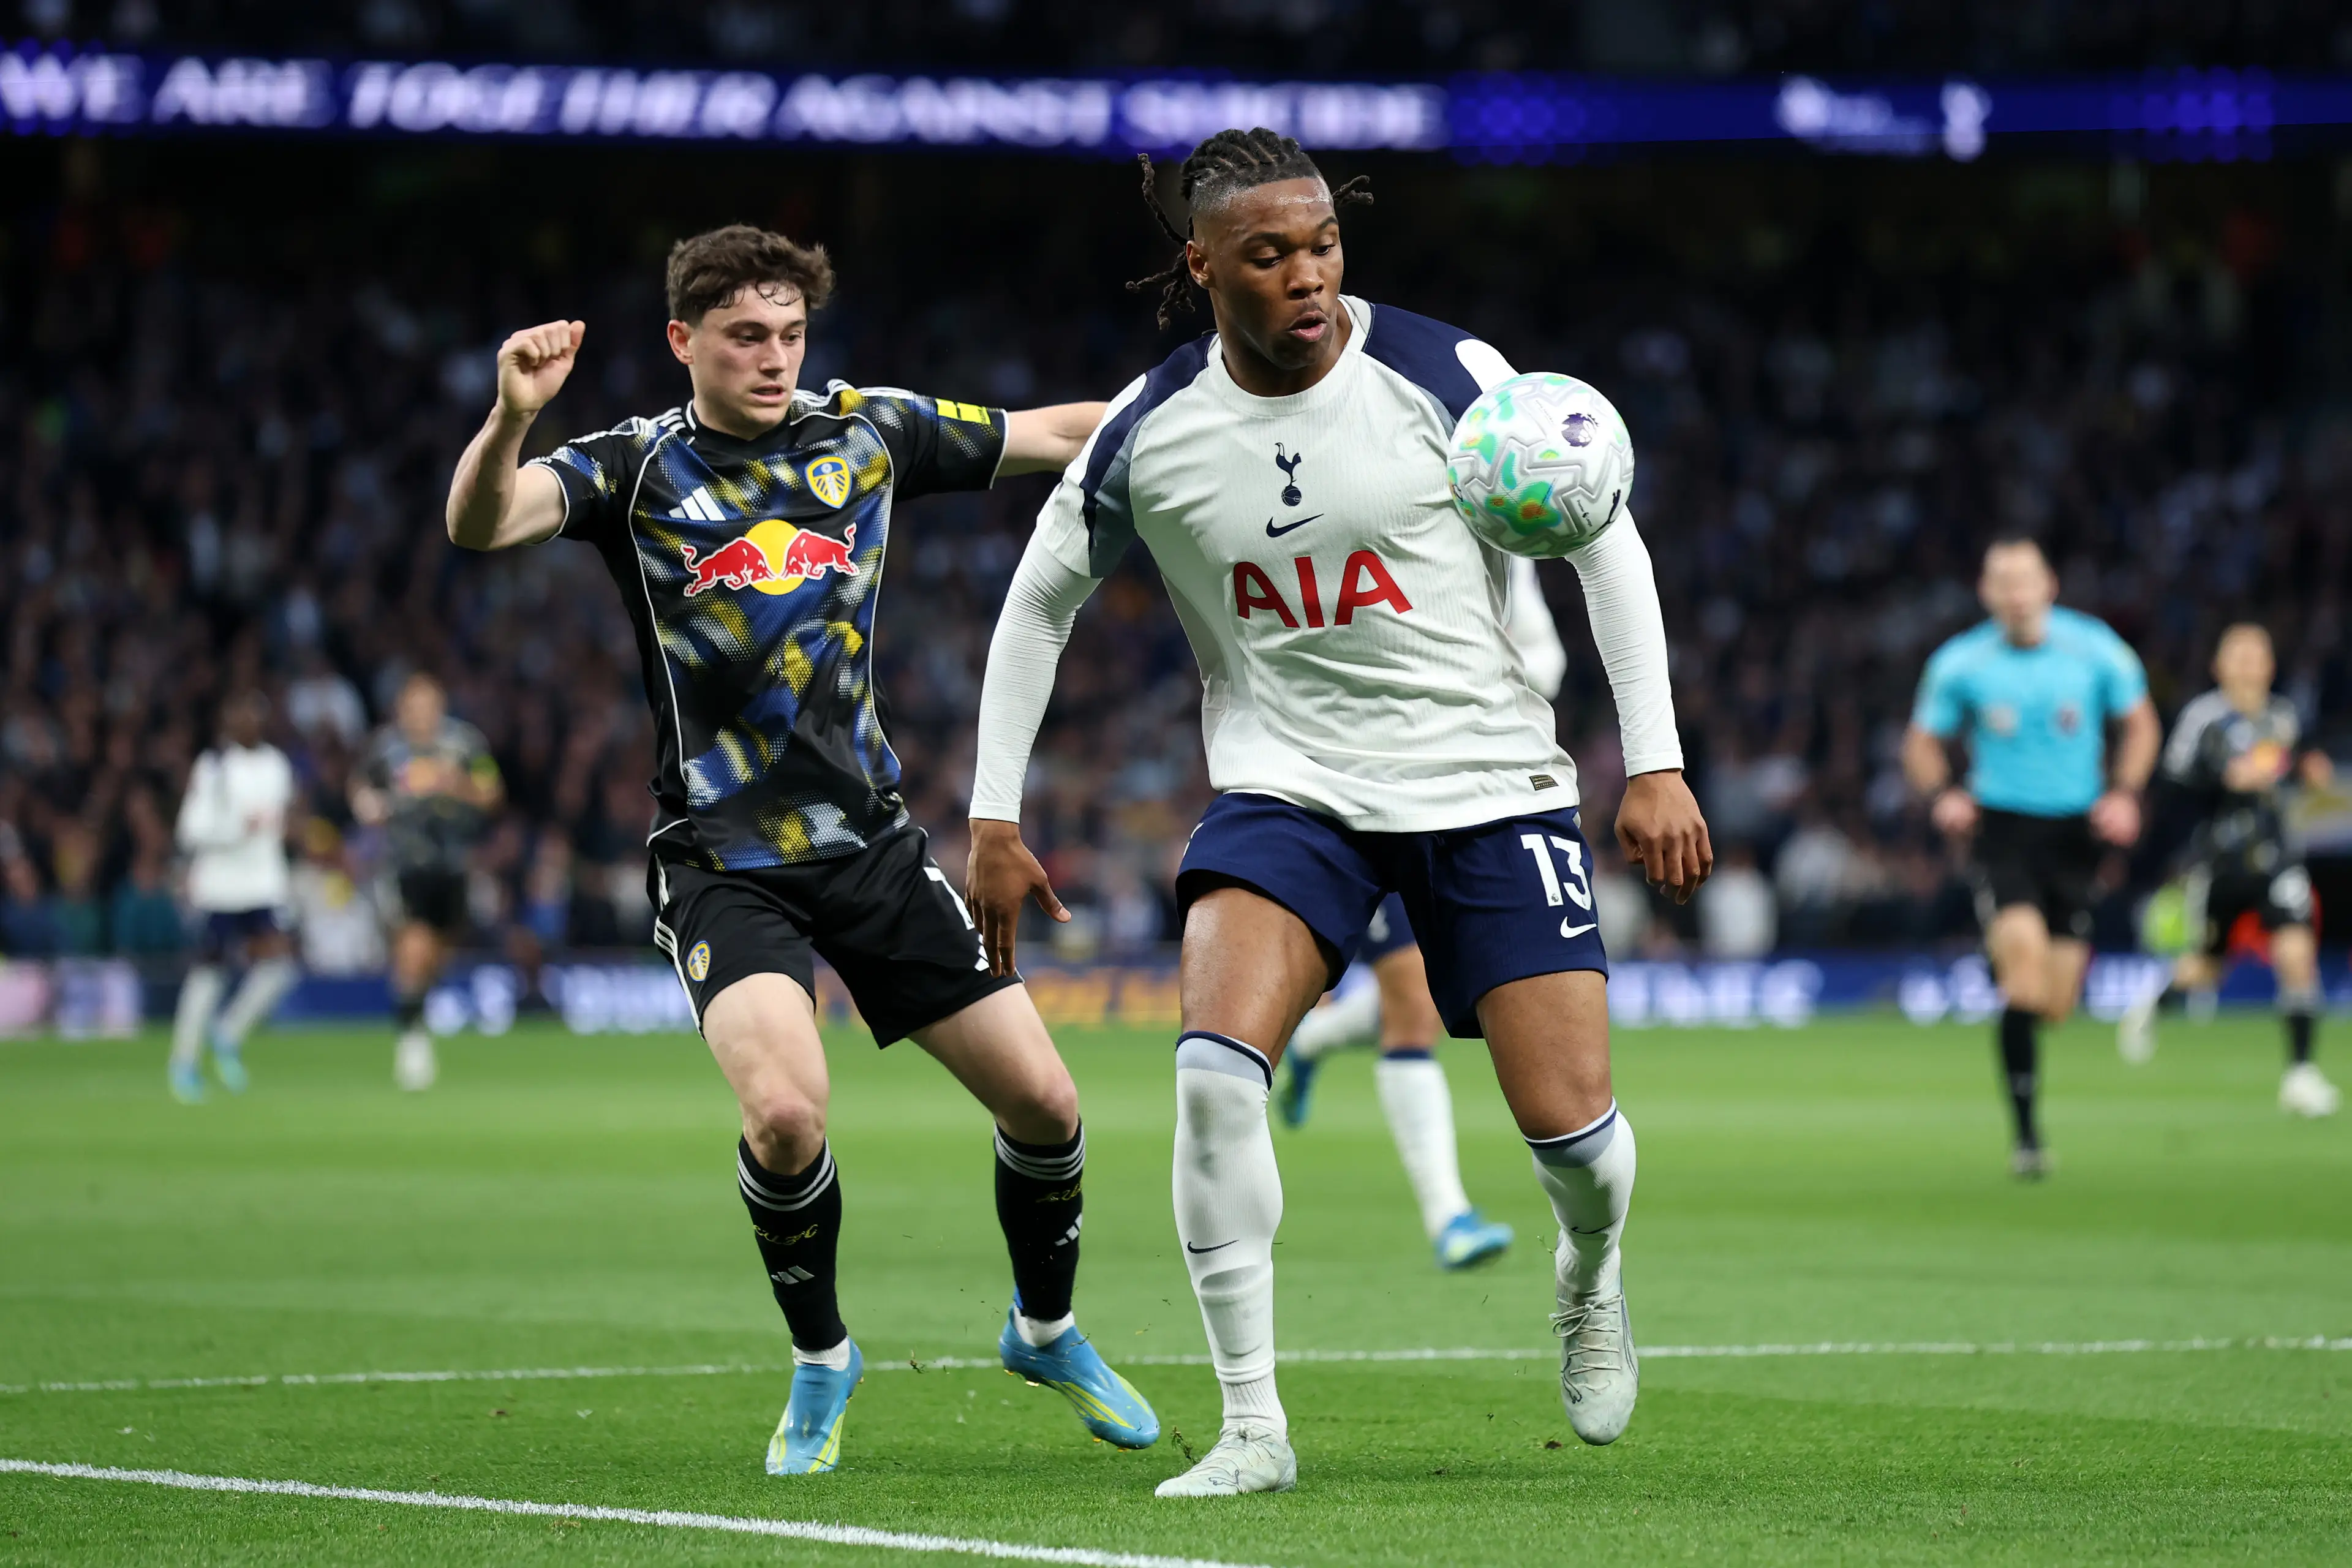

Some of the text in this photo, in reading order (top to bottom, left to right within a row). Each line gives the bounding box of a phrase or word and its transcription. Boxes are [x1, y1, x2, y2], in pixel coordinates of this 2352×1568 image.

[0, 51, 145, 124] WE
[153, 57, 334, 127] ARE
[347, 60, 778, 140] TOGETHER
[774, 73, 1110, 146] AGAINST
[1233, 550, 1413, 628] AIA
[1520, 833, 1593, 911] 13
